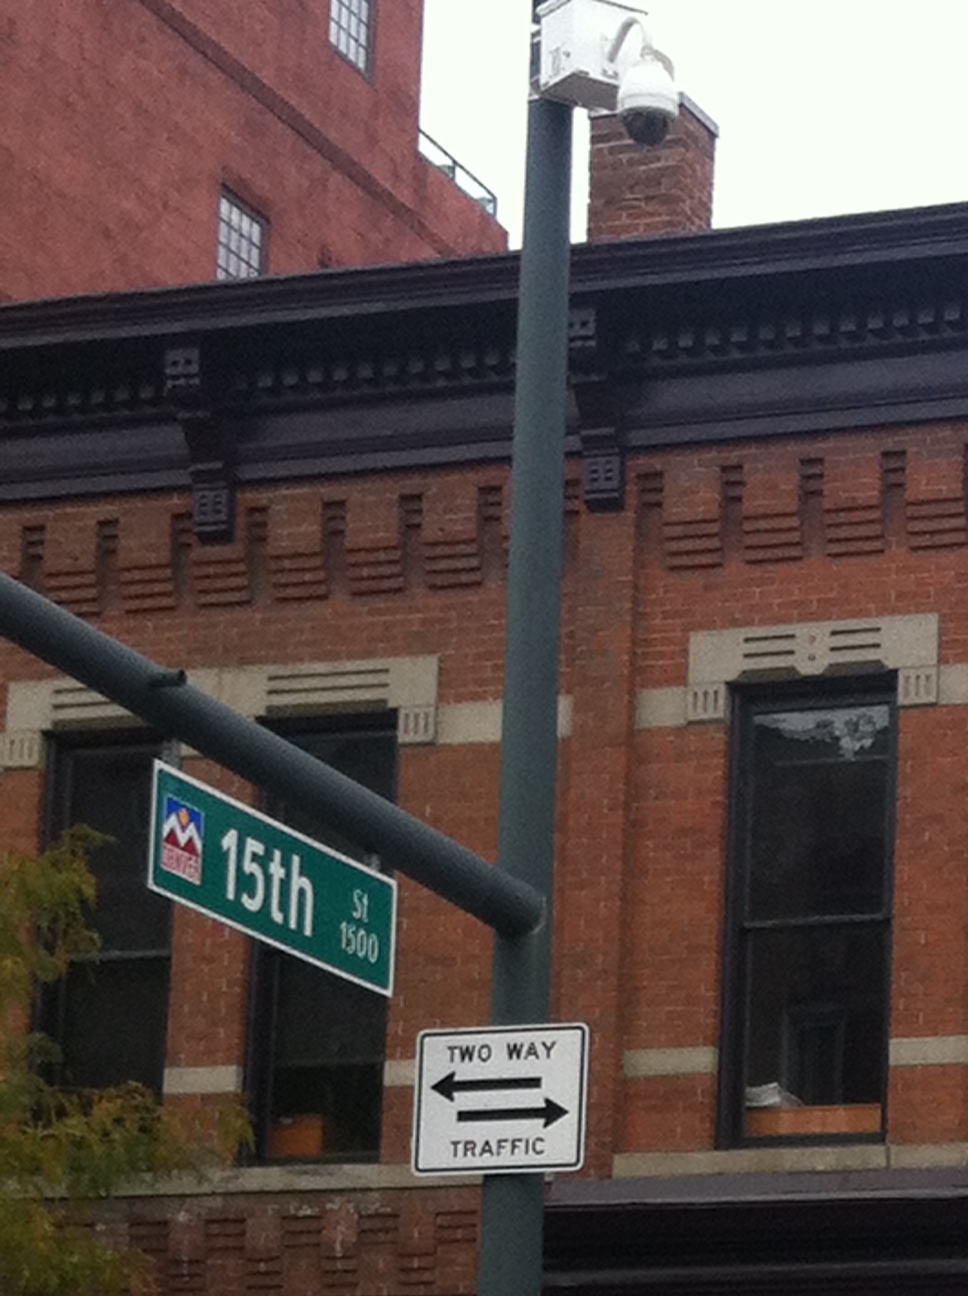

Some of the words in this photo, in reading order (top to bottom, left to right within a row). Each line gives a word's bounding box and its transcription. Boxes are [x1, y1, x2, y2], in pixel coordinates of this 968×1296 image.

[221, 828, 314, 937] 15th
[352, 889, 369, 923] St
[339, 920, 379, 963] 1500
[447, 1043, 492, 1063] TWO
[506, 1041, 557, 1061] WAY
[450, 1138, 546, 1158] TRAFFIC
